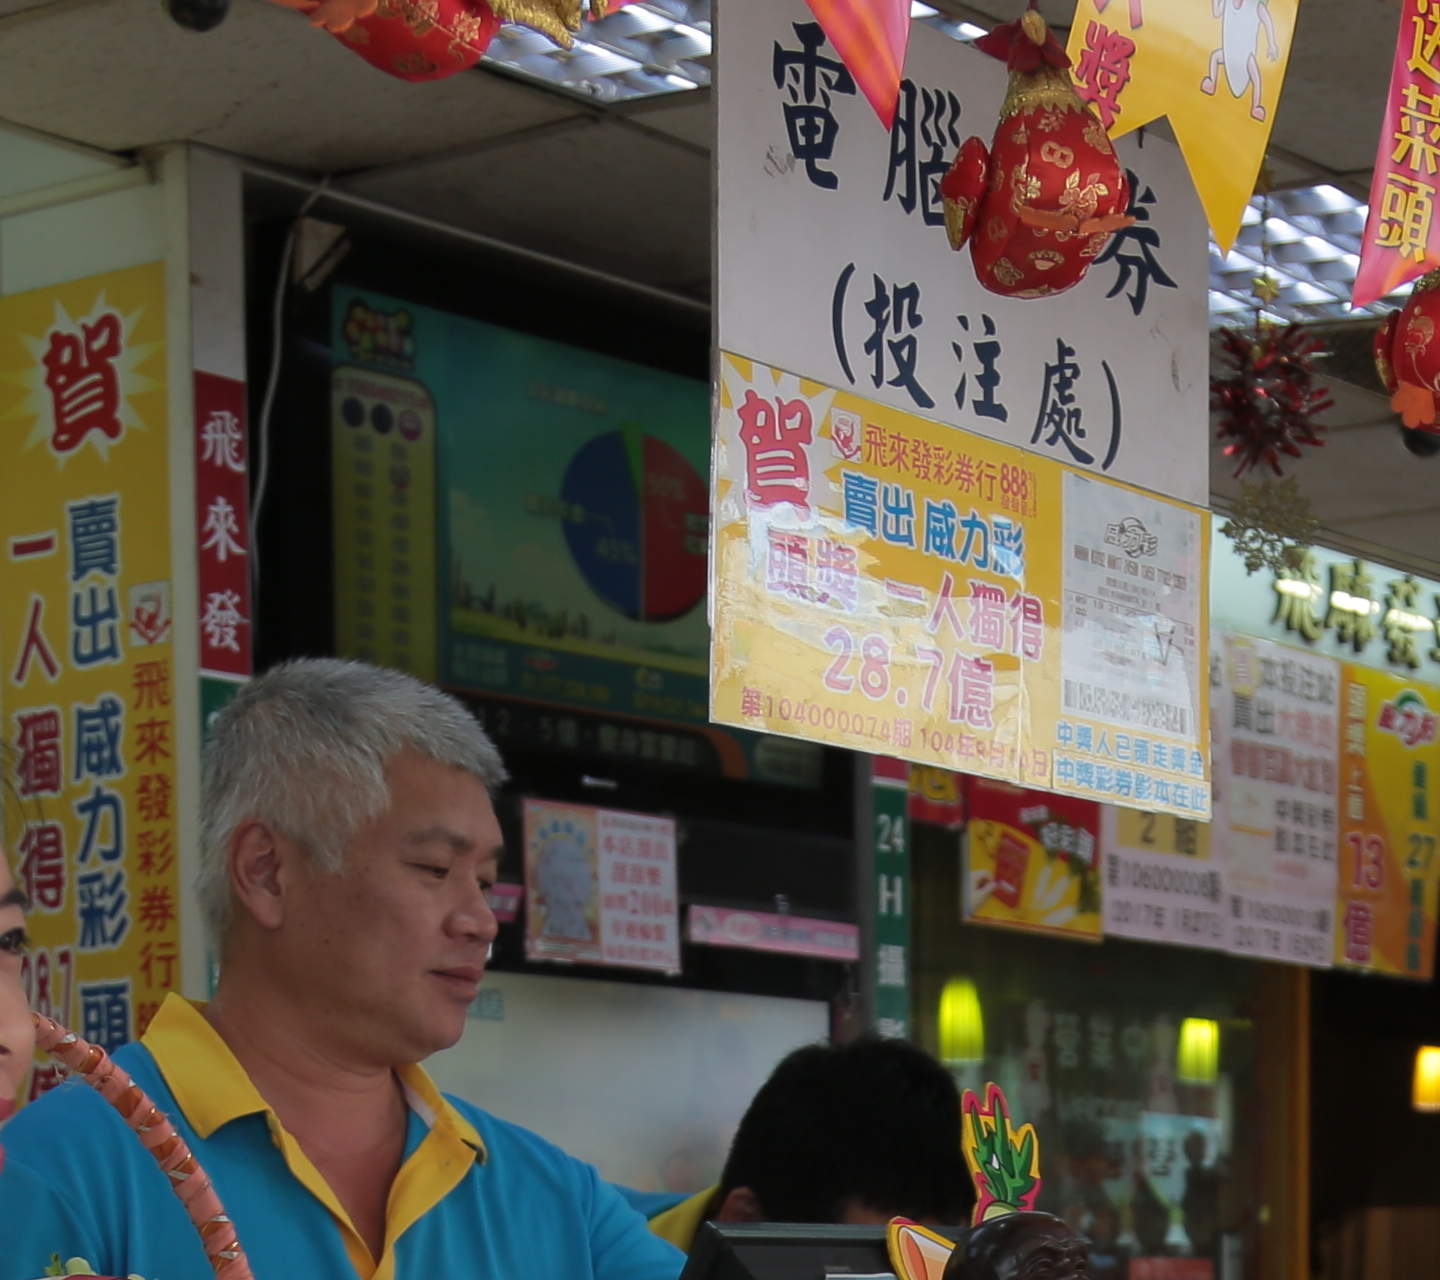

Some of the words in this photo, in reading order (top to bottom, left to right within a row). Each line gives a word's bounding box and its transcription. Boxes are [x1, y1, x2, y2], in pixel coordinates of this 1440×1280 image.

[773, 20, 1178, 315] 電腦券
[43, 312, 122, 453] 賀
[834, 262, 1123, 471] (投注處)
[739, 390, 812, 523] 賀
[842, 471, 915, 546] 賣出
[925, 500, 1025, 578] 威力彩
[866, 423, 996, 501] 飛來發彩券行
[68, 499, 122, 665] 賣出
[202, 411, 248, 652] 飛來發
[824, 627, 997, 729] 28.7億
[885, 572, 1044, 660] 一人獨得
[11, 537, 65, 910] 一人獨得
[741, 686, 912, 749] 第104000074期
[1057, 757, 1208, 814] 中獎彩券影本在此
[75, 701, 128, 950] 威力彩
[132, 661, 178, 990] 飛來發彩券行
